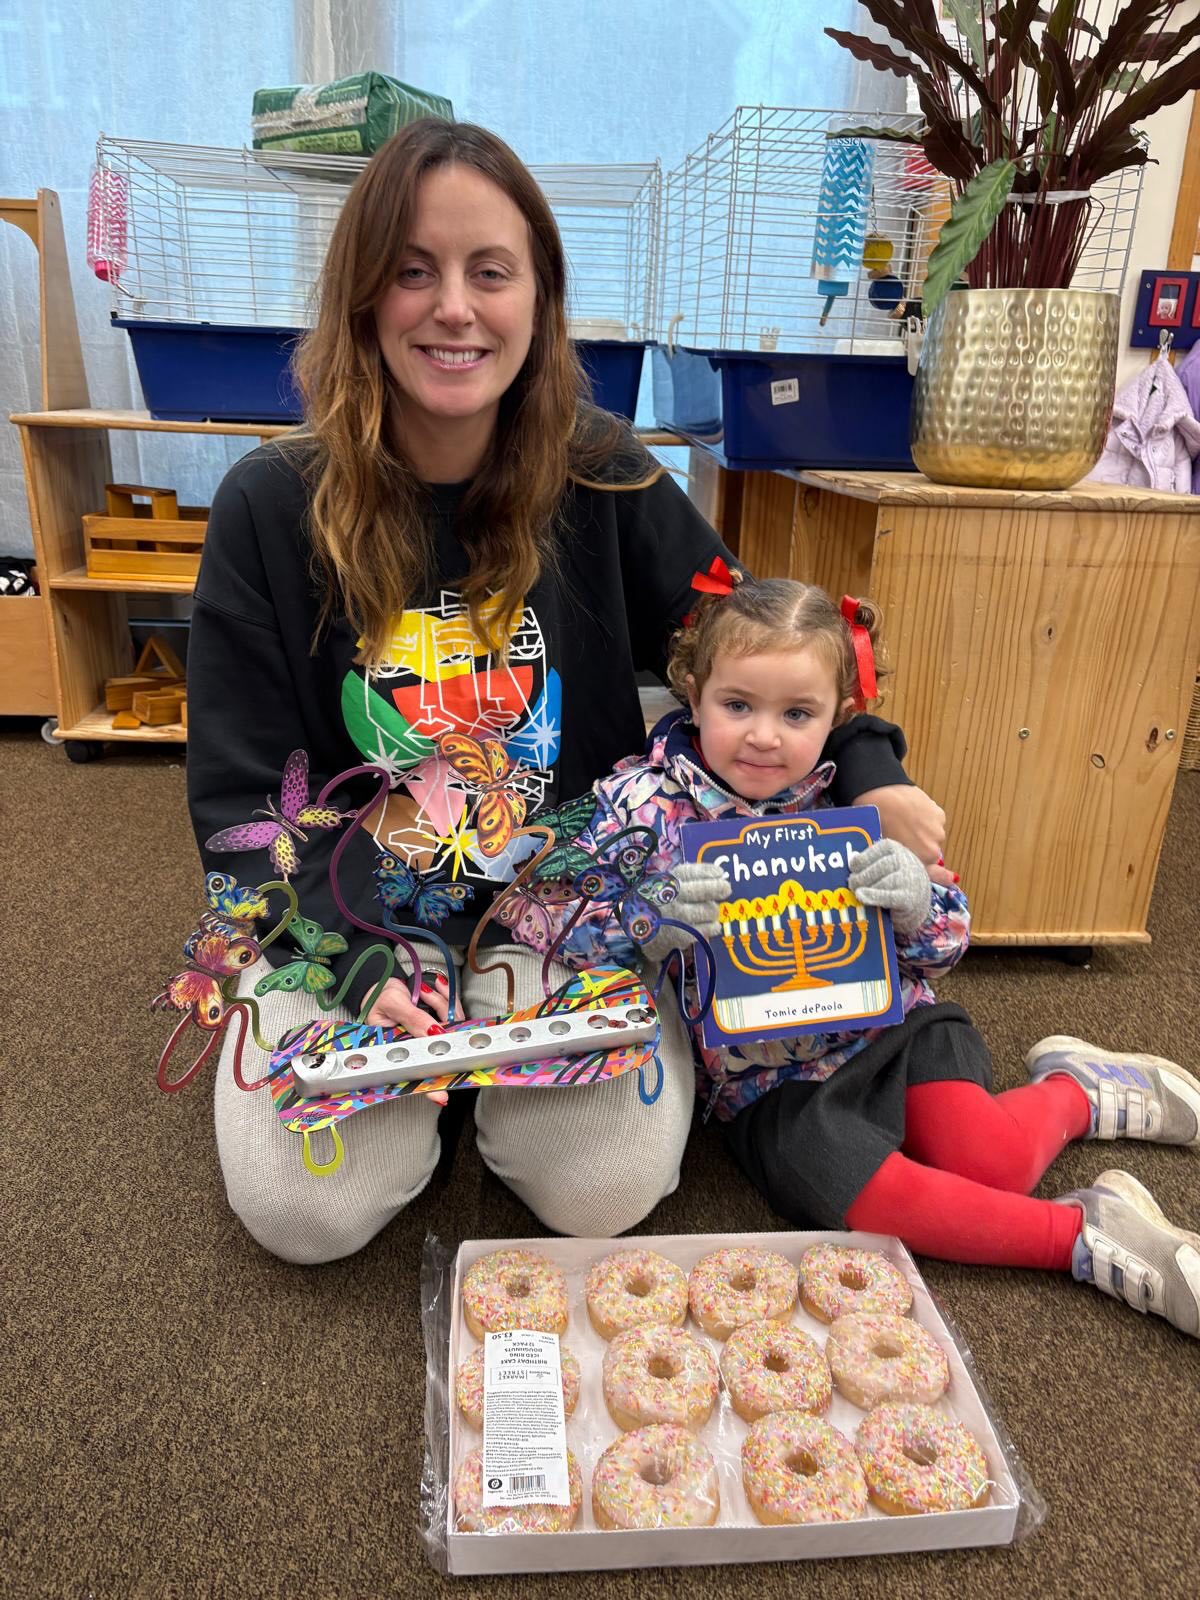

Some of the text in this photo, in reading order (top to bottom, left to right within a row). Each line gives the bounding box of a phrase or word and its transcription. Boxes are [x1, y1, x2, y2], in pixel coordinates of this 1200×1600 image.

[746, 825, 814, 849] My First
[765, 1001, 843, 1019] Tomie dePaola
[491, 1332, 512, 1340] £3.50
